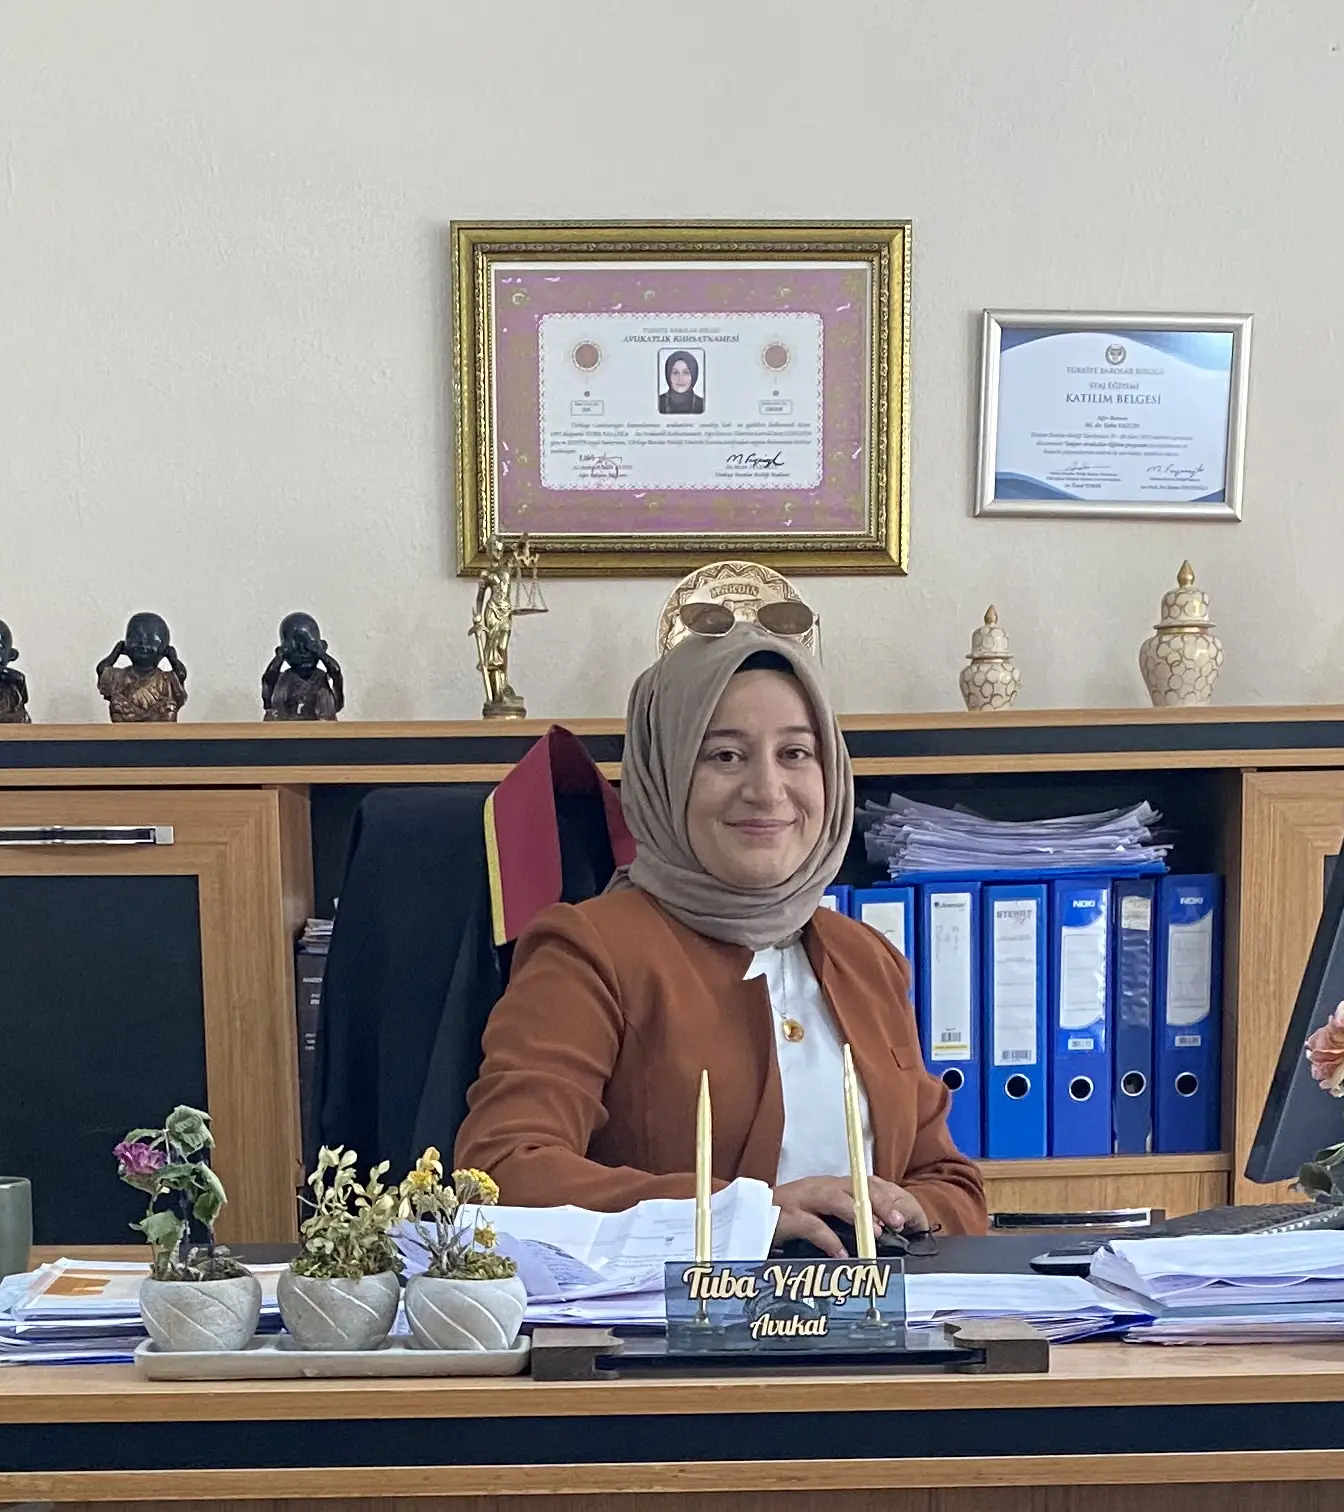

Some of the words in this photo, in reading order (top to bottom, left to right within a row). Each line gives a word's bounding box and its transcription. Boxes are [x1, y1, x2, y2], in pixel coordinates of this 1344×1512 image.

[1065, 393, 1113, 404] KATILIM
[1116, 393, 1161, 405] BELGESİ
[682, 1264, 759, 1299] Tuba
[750, 1312, 829, 1339] Avukat
